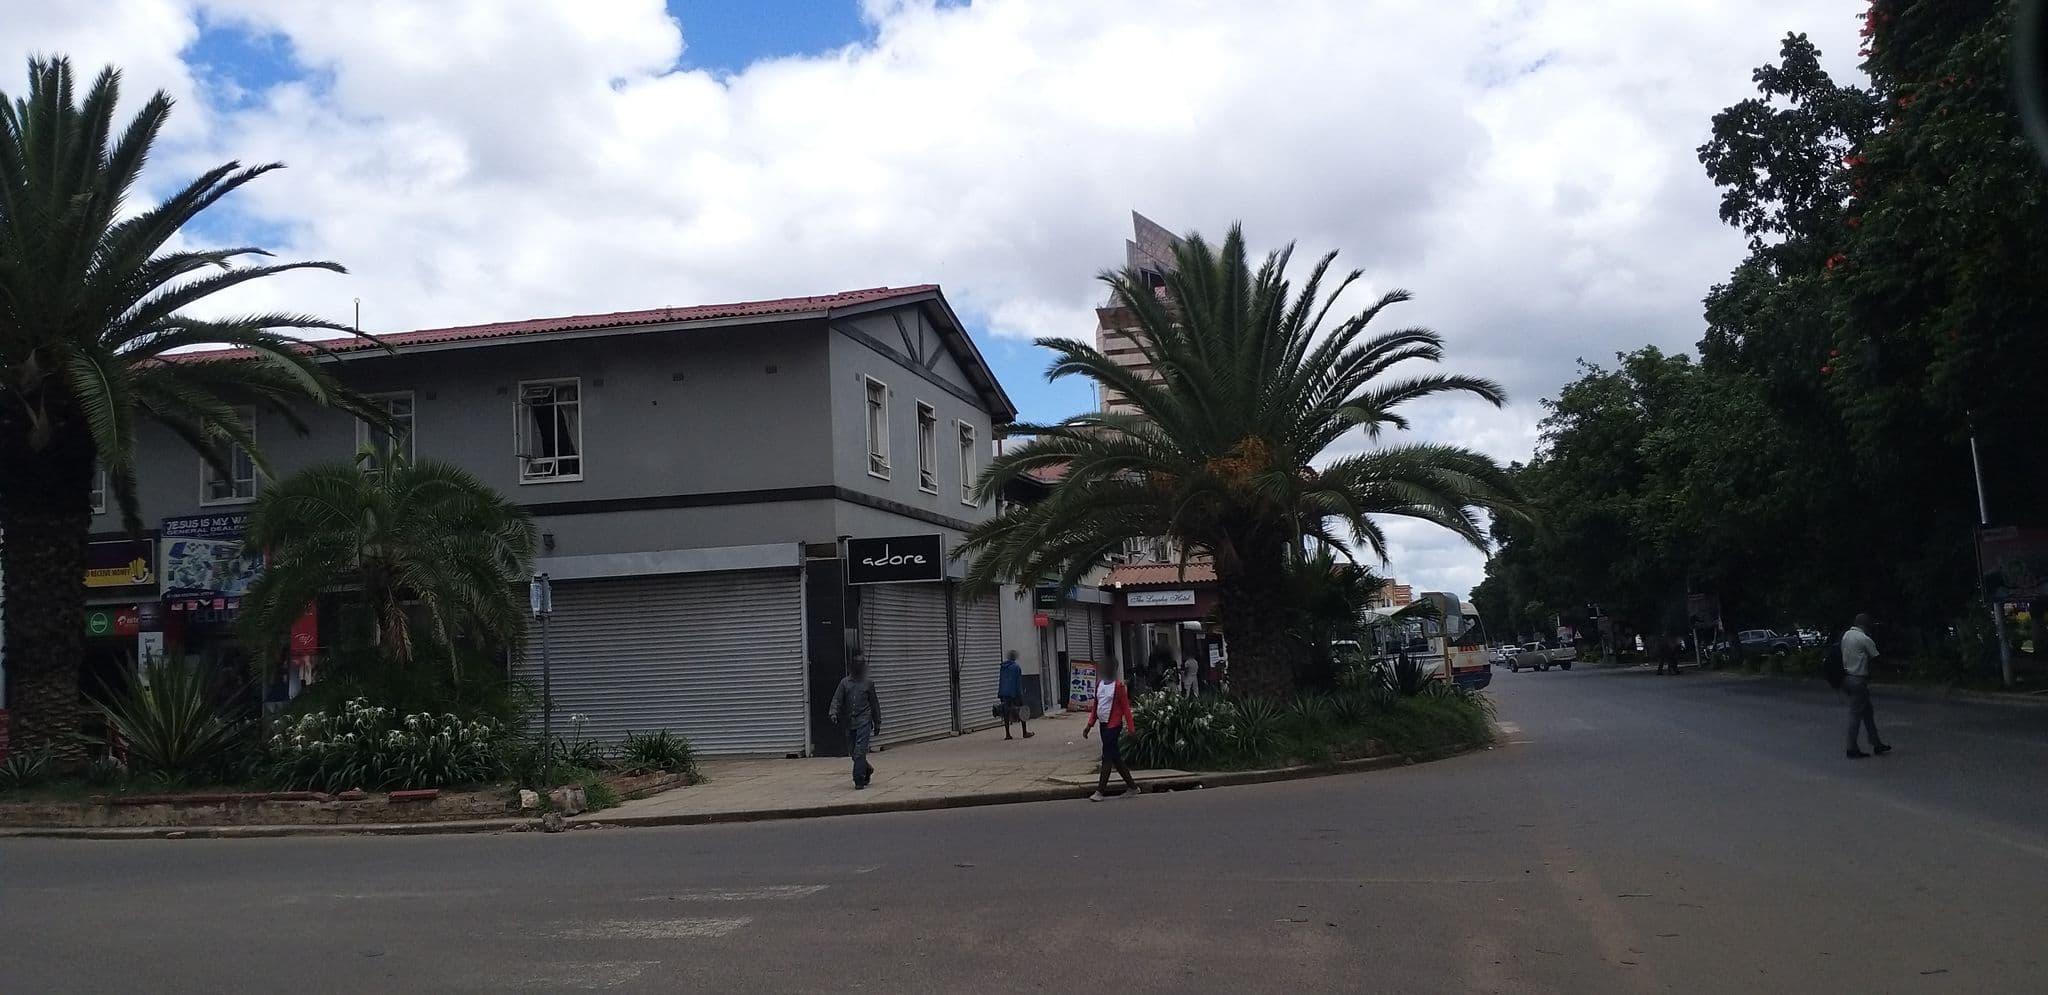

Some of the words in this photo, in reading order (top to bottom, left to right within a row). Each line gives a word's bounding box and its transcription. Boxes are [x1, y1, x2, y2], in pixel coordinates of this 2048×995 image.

[166, 519, 199, 531] JESUS
[200, 518, 210, 527] IS
[212, 516, 229, 526] MY
[166, 527, 209, 536] GENERAL
[862, 543, 927, 566] adore
[90, 569, 110, 577] RECEIVE
[111, 568, 130, 577] MONEY
[1170, 593, 1191, 601] Hotel
